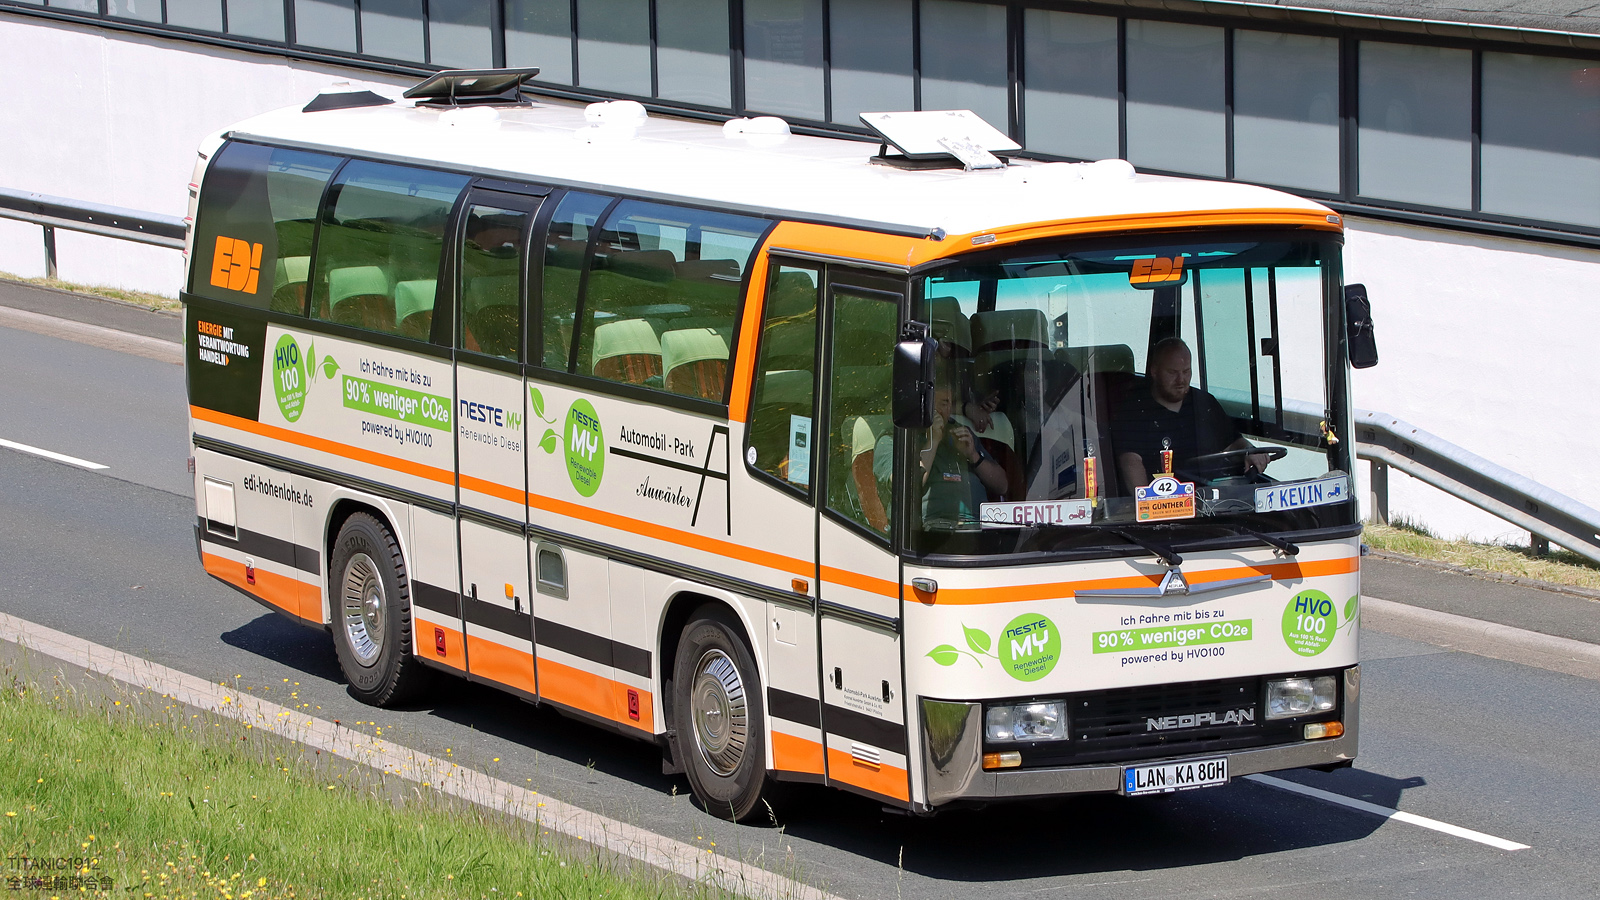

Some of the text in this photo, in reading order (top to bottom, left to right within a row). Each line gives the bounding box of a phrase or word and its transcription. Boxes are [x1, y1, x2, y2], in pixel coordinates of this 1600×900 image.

[198, 320, 233, 340] ENERGIE MIT
[198, 334, 250, 358] VERANTWORTUNG
[199, 348, 226, 366] HANDELN
[276, 343, 297, 370] HVO
[281, 367, 298, 392] 100
[360, 358, 431, 387] Ich fahre mit bis zu
[373, 390, 418, 419] weniger
[422, 396, 449, 423] CO2e
[460, 400, 522, 431] NESTE MY
[362, 421, 432, 447] powered by HVO100
[460, 426, 522, 452] Renewable Diesel
[571, 424, 598, 462] MY
[620, 426, 666, 452] Automobil
[674, 438, 694, 458] Park
[570, 458, 597, 480] Renewable
[576, 470, 591, 487] Diesel
[243, 475, 313, 508] edi-hohenlohe.de
[636, 476, 693, 509] Auwärter
[1158, 483, 1172, 491] 42
[1280, 484, 1322, 507] KEVIN
[1013, 505, 1063, 524] GENTI
[1152, 502, 1183, 510] GÜNTHER
[1295, 596, 1331, 616] HVO
[1006, 620, 1047, 638] NESTE
[1120, 616, 1135, 626] Ich
[1140, 614, 1170, 624] fahre
[1174, 611, 1191, 621] mit
[1196, 610, 1210, 619] bis
[1297, 614, 1325, 634] 100
[1010, 629, 1049, 660] MY
[1140, 627, 1205, 645] weniger
[1210, 623, 1248, 638] CO2e
[1014, 654, 1053, 671] Renewable
[1121, 647, 1225, 667] powered by HVO100
[1024, 664, 1046, 676] Diesel
[1146, 707, 1254, 732] NEOPLAN
[1137, 768, 1166, 788] LAN
[1176, 765, 1194, 784] KA
[1198, 761, 1224, 781] 80H
